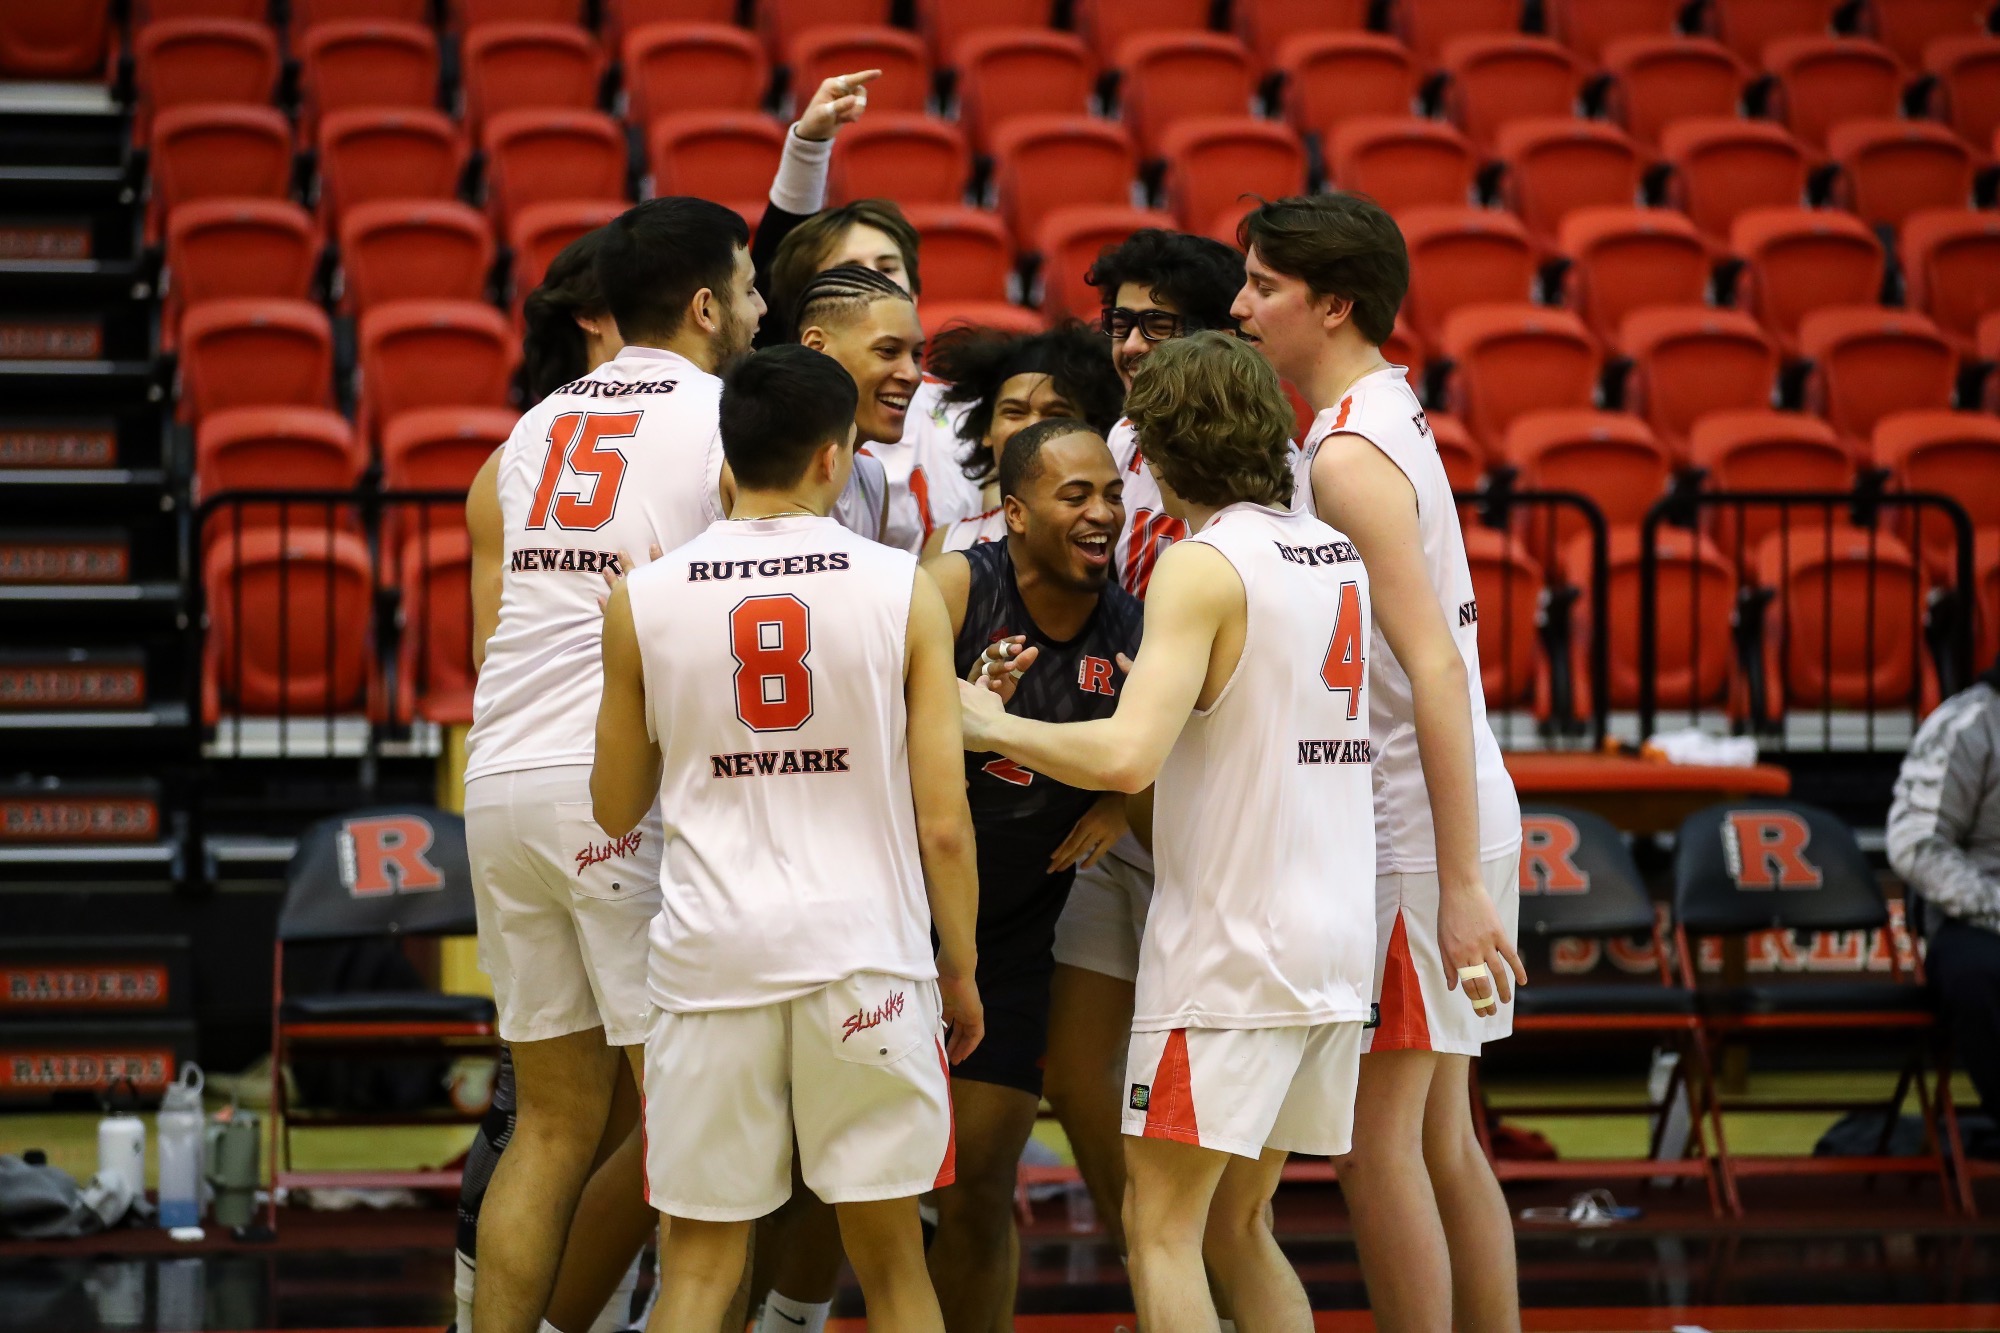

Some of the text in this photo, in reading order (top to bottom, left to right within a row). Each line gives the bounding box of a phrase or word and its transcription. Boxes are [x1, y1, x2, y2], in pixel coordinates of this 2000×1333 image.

[554, 379, 679, 399] RUTGERS
[525, 410, 644, 532] 15
[511, 548, 623, 577] NEWARK
[687, 552, 851, 583] RUTGERS
[1272, 540, 1361, 566] RUTGER
[729, 593, 814, 733] 8
[1320, 581, 1365, 720] 4
[1079, 655, 1115, 696] R
[710, 748, 850, 778] NEWARK
[1298, 739, 1371, 765] NEWARK
[342, 814, 445, 899] R
[1725, 810, 1823, 891] R
[10, 969, 161, 1001] RAIDERS
[11, 1054, 166, 1087] RAIDERS
